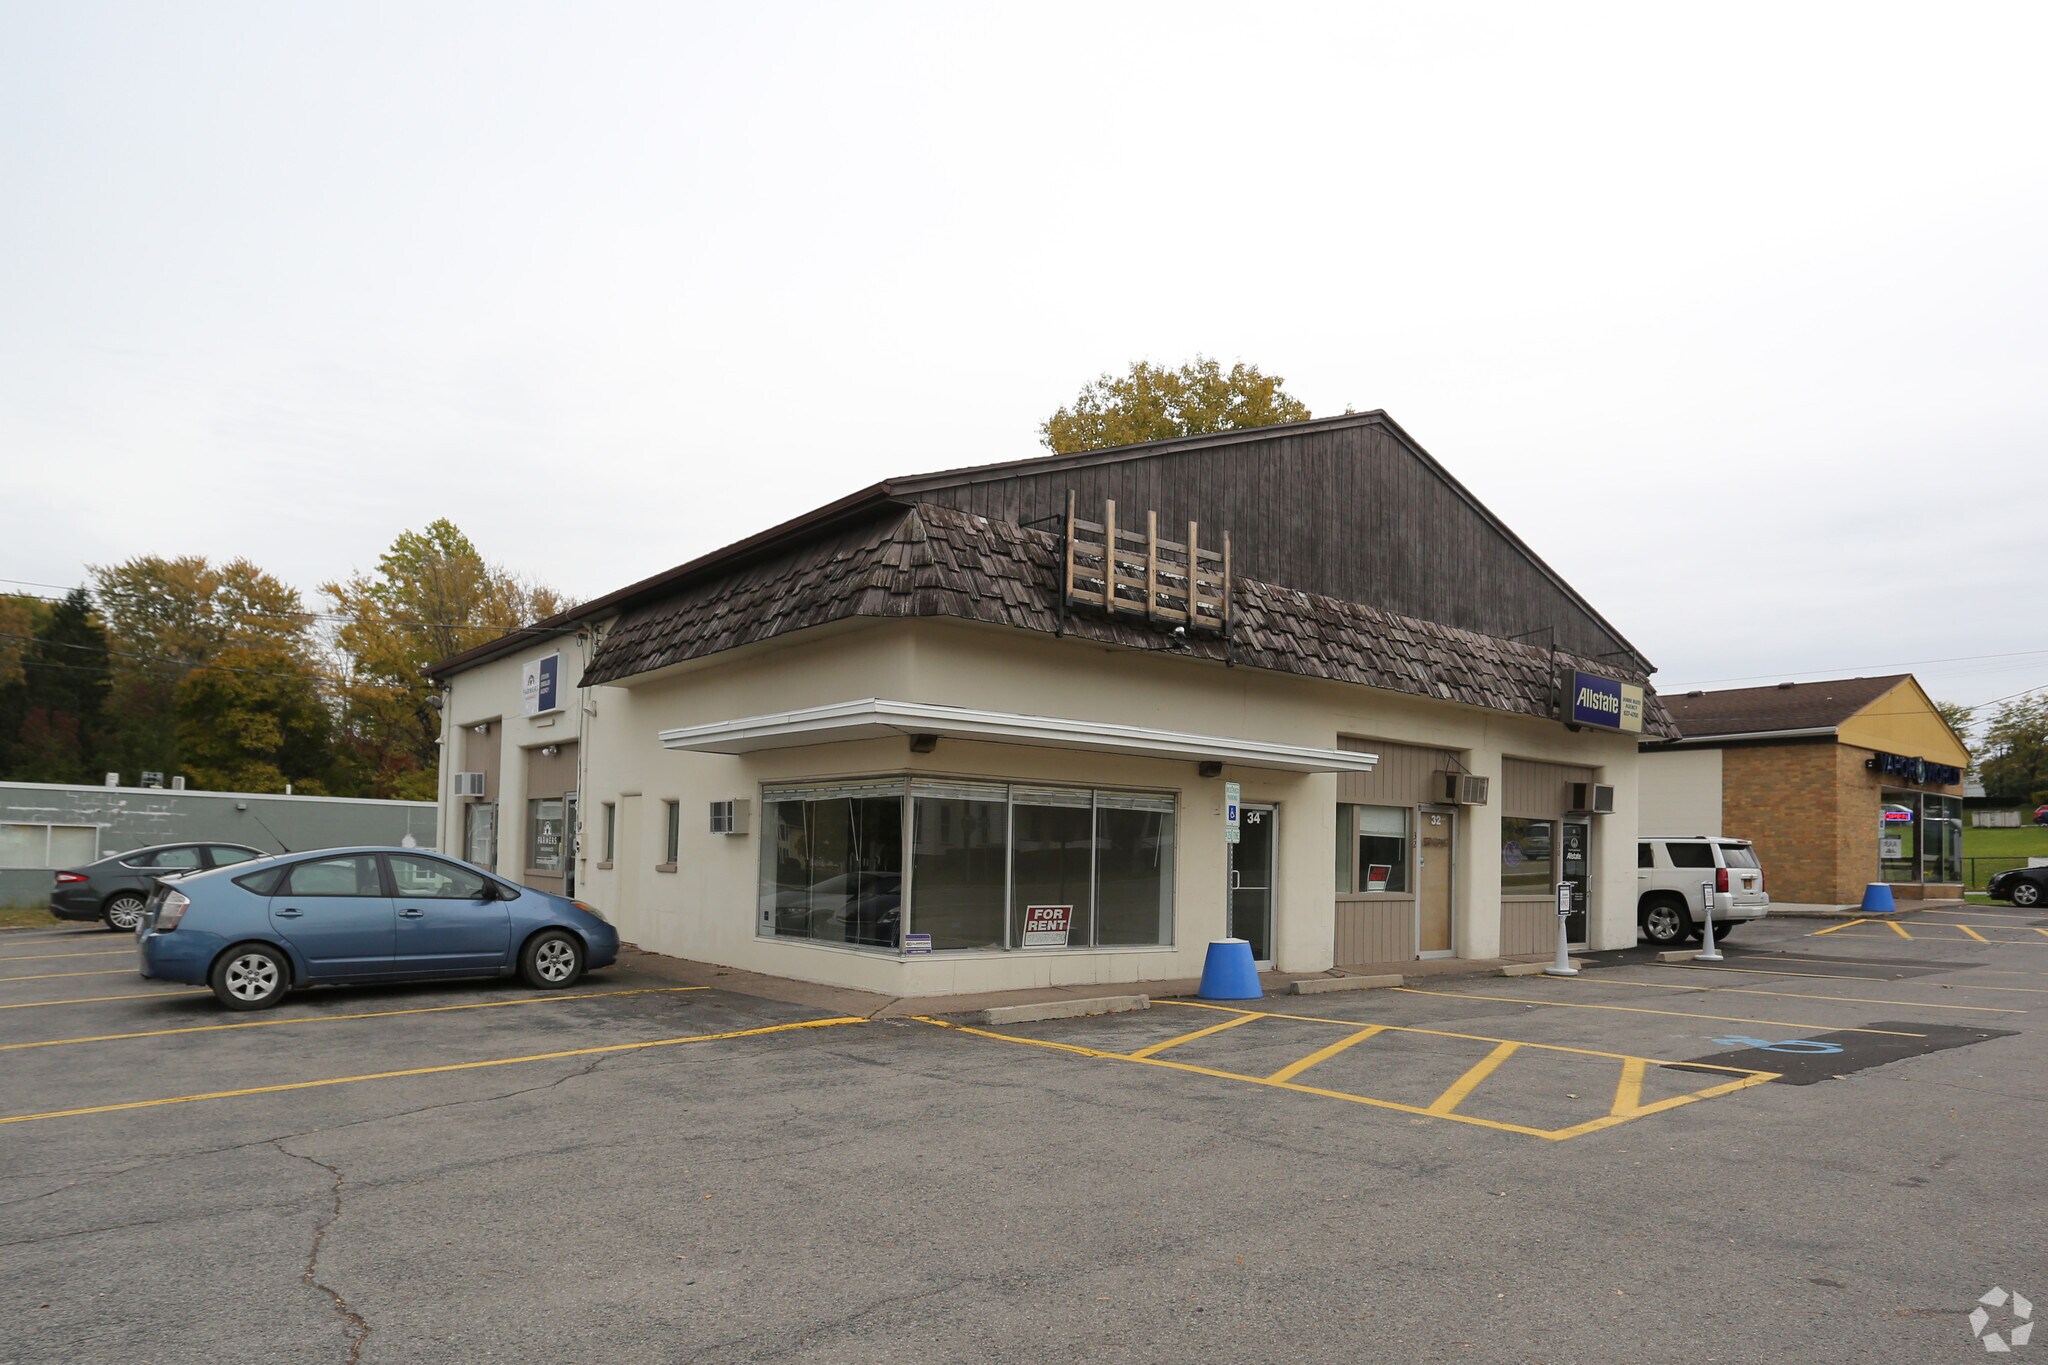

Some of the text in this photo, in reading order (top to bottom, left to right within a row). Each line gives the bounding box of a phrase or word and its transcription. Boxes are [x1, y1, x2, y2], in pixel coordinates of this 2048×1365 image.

[1576, 687, 1619, 714] Allstate
[1247, 811, 1261, 824] 34
[1430, 815, 1442, 826] 32
[537, 836, 557, 845] FARMERS
[1034, 908, 1064, 920] FOR
[1027, 919, 1067, 931] RENT
